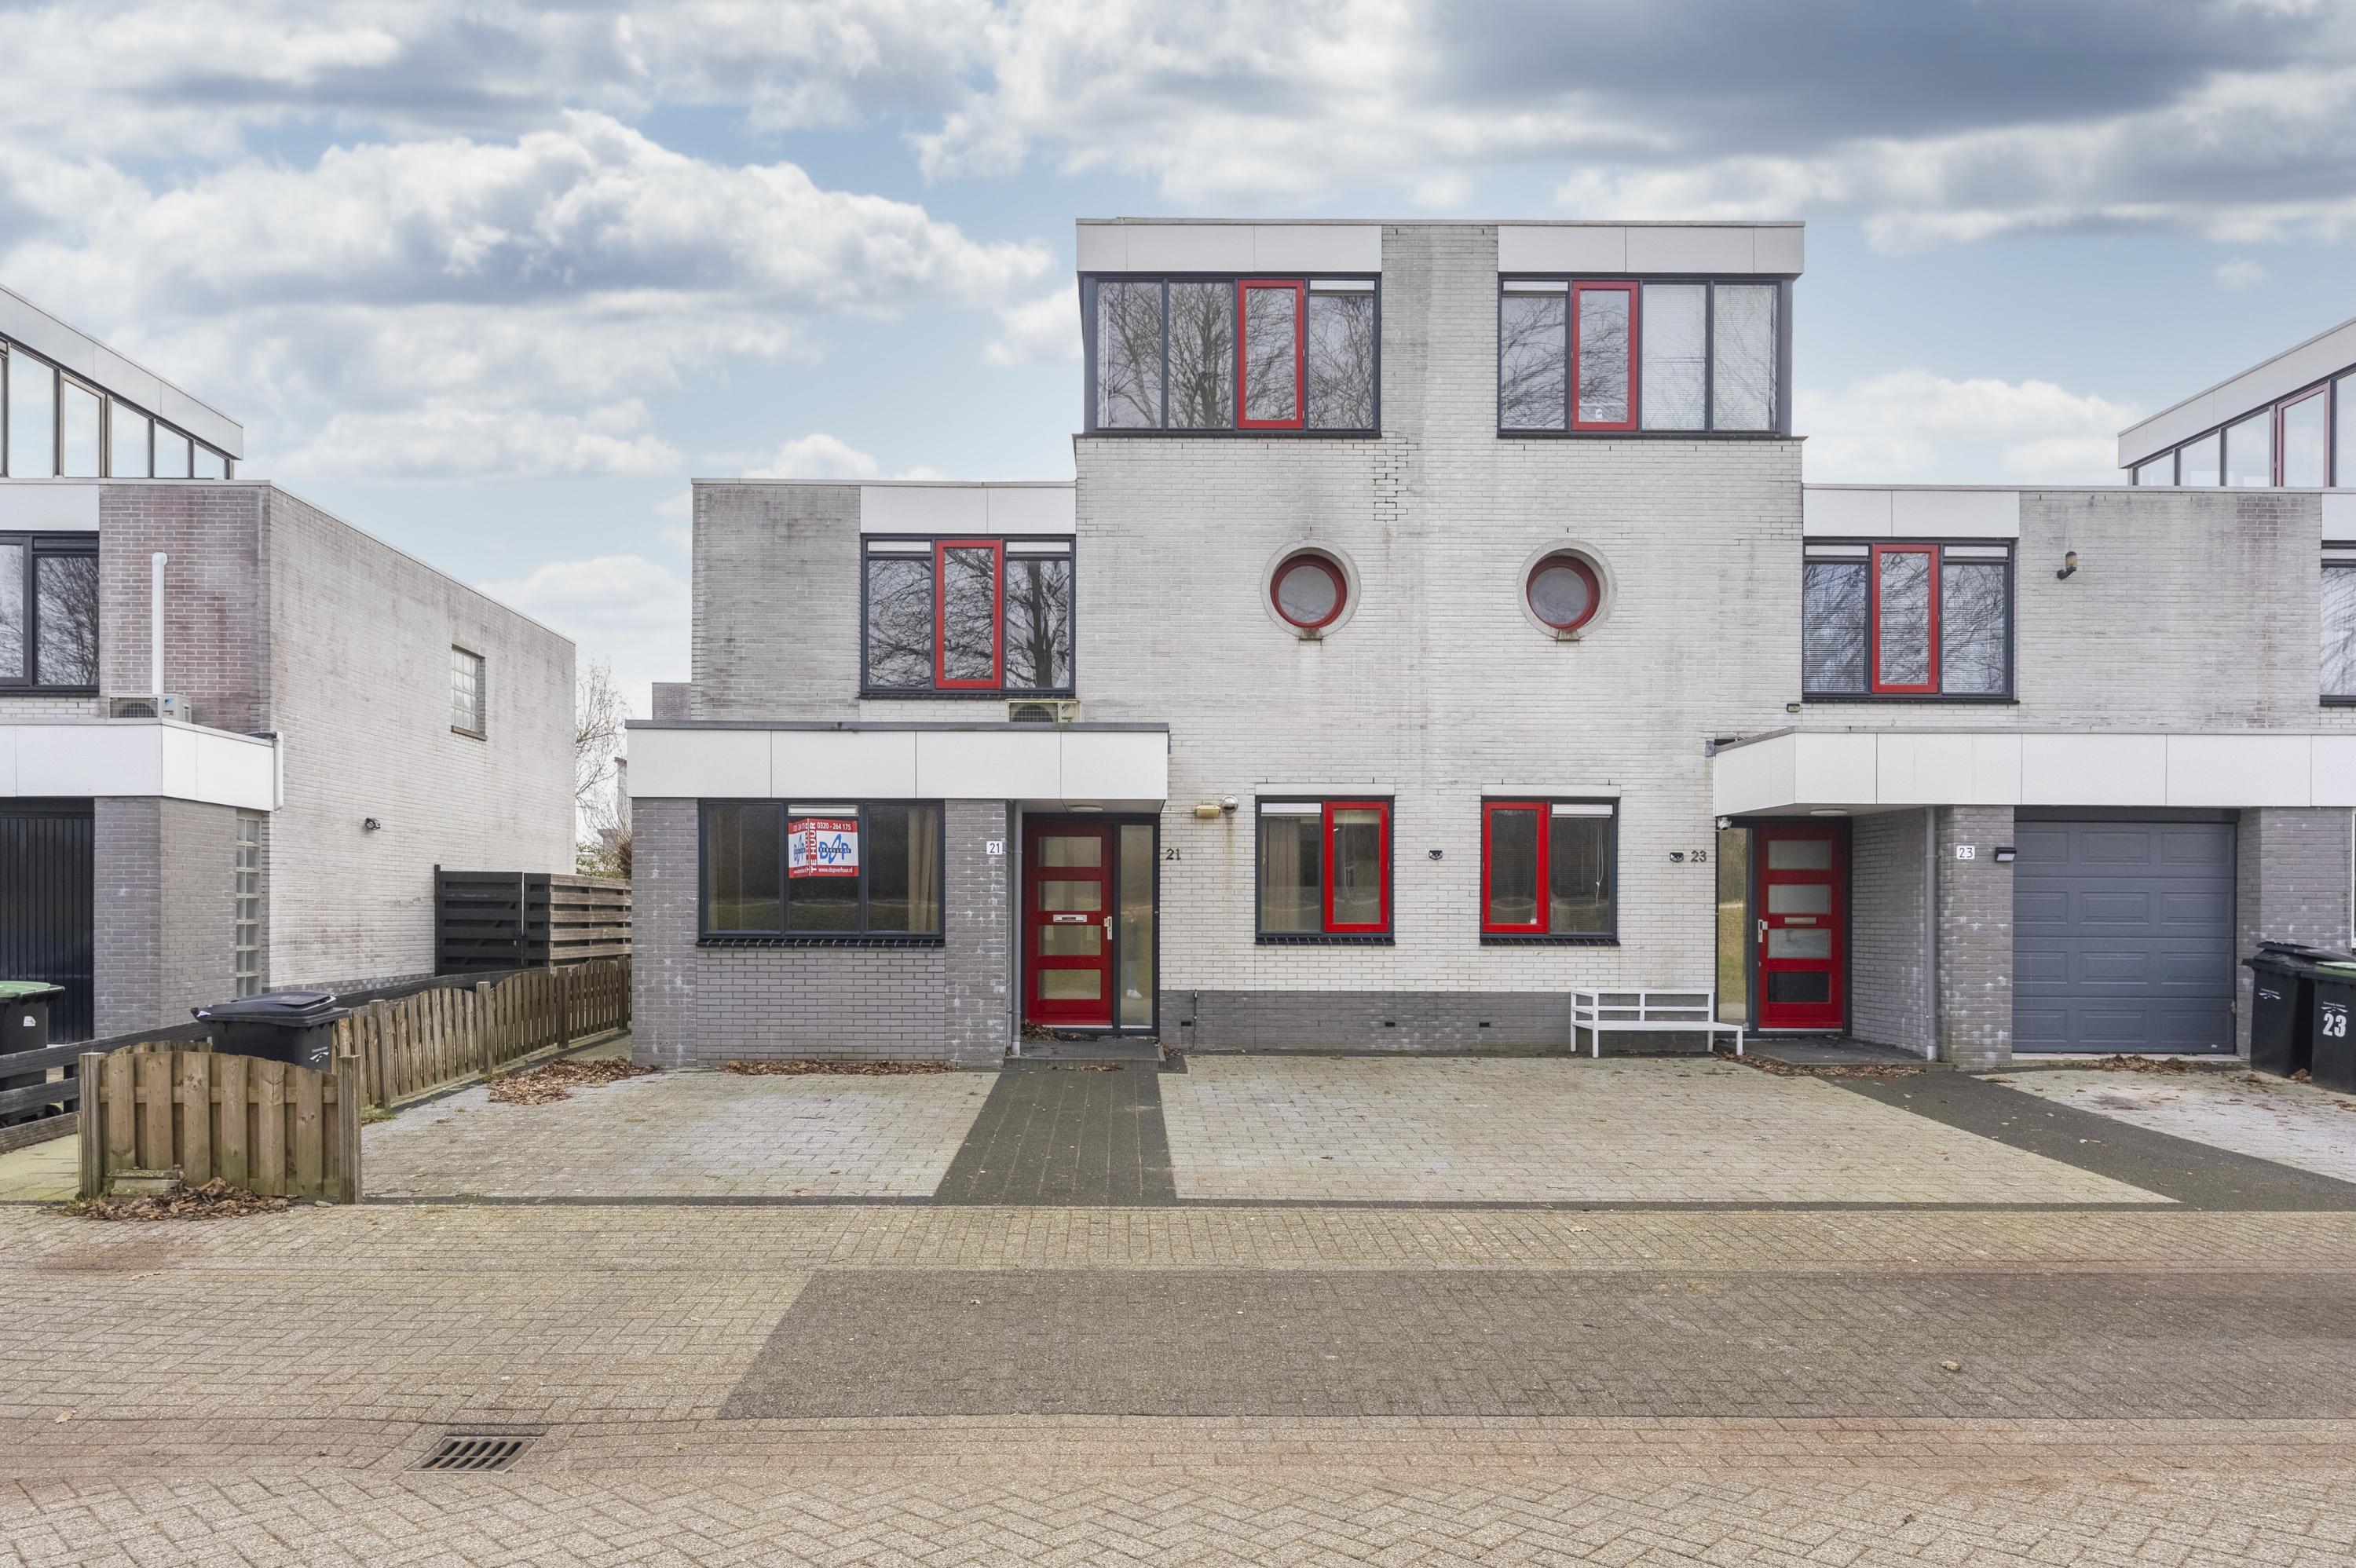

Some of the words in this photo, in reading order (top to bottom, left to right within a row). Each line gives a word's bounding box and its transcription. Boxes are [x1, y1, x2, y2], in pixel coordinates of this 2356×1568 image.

[819, 833, 850, 864] DOP
[990, 842, 1000, 853] 21
[1959, 847, 1973, 858] 23
[1165, 848, 1181, 861] 21
[1690, 850, 1707, 863] 23
[810, 859, 818, 873] TE
[2322, 1012, 2347, 1037] 23
